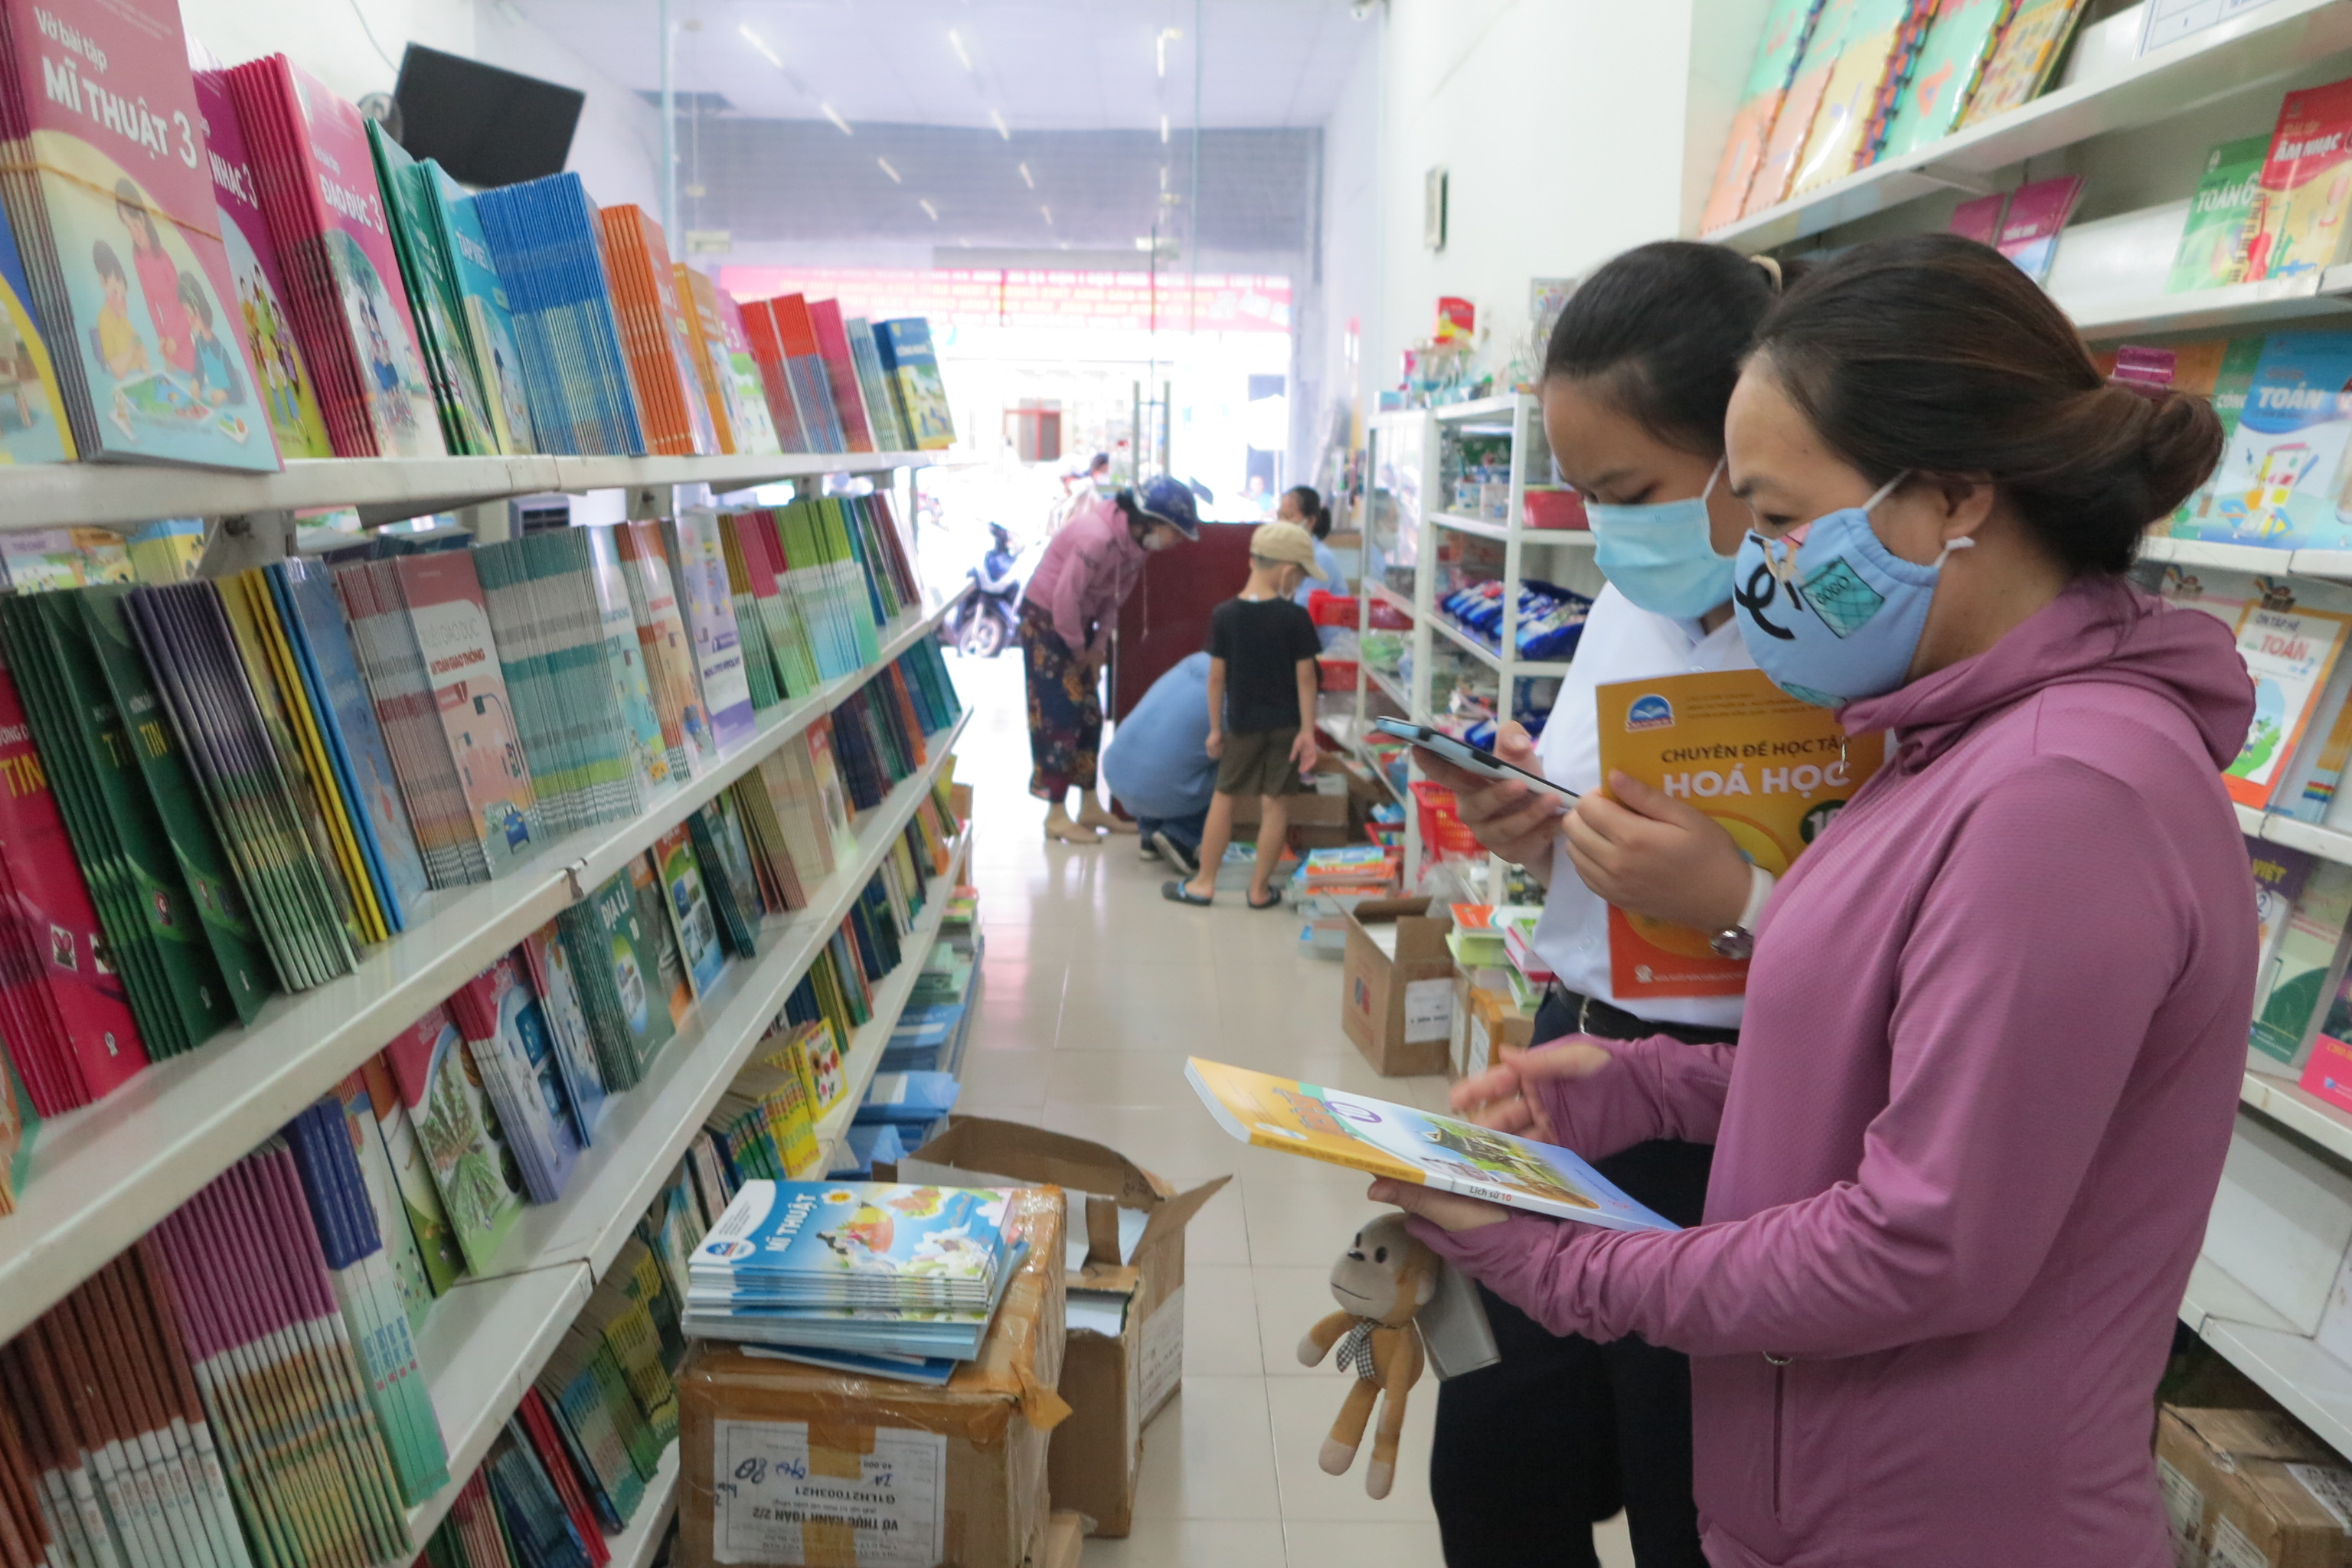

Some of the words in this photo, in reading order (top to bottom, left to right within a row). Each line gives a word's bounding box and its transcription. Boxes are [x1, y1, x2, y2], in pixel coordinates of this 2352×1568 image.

[34, 6, 57, 40] Vở
[58, 18, 82, 56] bài
[83, 37, 109, 74] tập
[42, 55, 83, 113] MĨ
[82, 77, 169, 161] THUẬT
[174, 109, 198, 169] 3
[2301, 132, 2344, 158] NHẠC
[207, 148, 248, 207] NHẠC
[242, 162, 259, 210] 3
[2197, 180, 2243, 214] TOÁN
[2244, 171, 2260, 207] 6
[318, 172, 348, 220] ĐẠO
[343, 185, 373, 229] ĐỨC
[369, 193, 384, 236] 3
[2259, 381, 2327, 410] TOÁN
[2260, 633, 2309, 662] TOÁN
[139, 720, 168, 759] TIN
[1661, 744, 1738, 763] CHUYÊN
[1743, 740, 1768, 758] ĐỀ
[1772, 737, 1813, 758] HỌC
[1819, 733, 1851, 753] TẬ
[0, 751, 47, 799] TIN
[1663, 763, 1753, 799] HOÁ
[1762, 760, 1851, 799] HỌC
[600, 895, 618, 932] ĐỊA
[616, 880, 631, 913] LÍ
[629, 916, 640, 942] 10
[1469, 1185, 1488, 1197] Lịch
[1488, 1188, 1501, 1200] sử
[1501, 1192, 1512, 1202] 10
[776, 1193, 819, 1241] THUẬT
[765, 1233, 794, 1253] MĨ
[752, 1506, 773, 1520] 2/2
[775, 1510, 807, 1525] TOÁN
[848, 1514, 879, 1530] THỰC
[882, 1518, 899, 1537] VỞ
